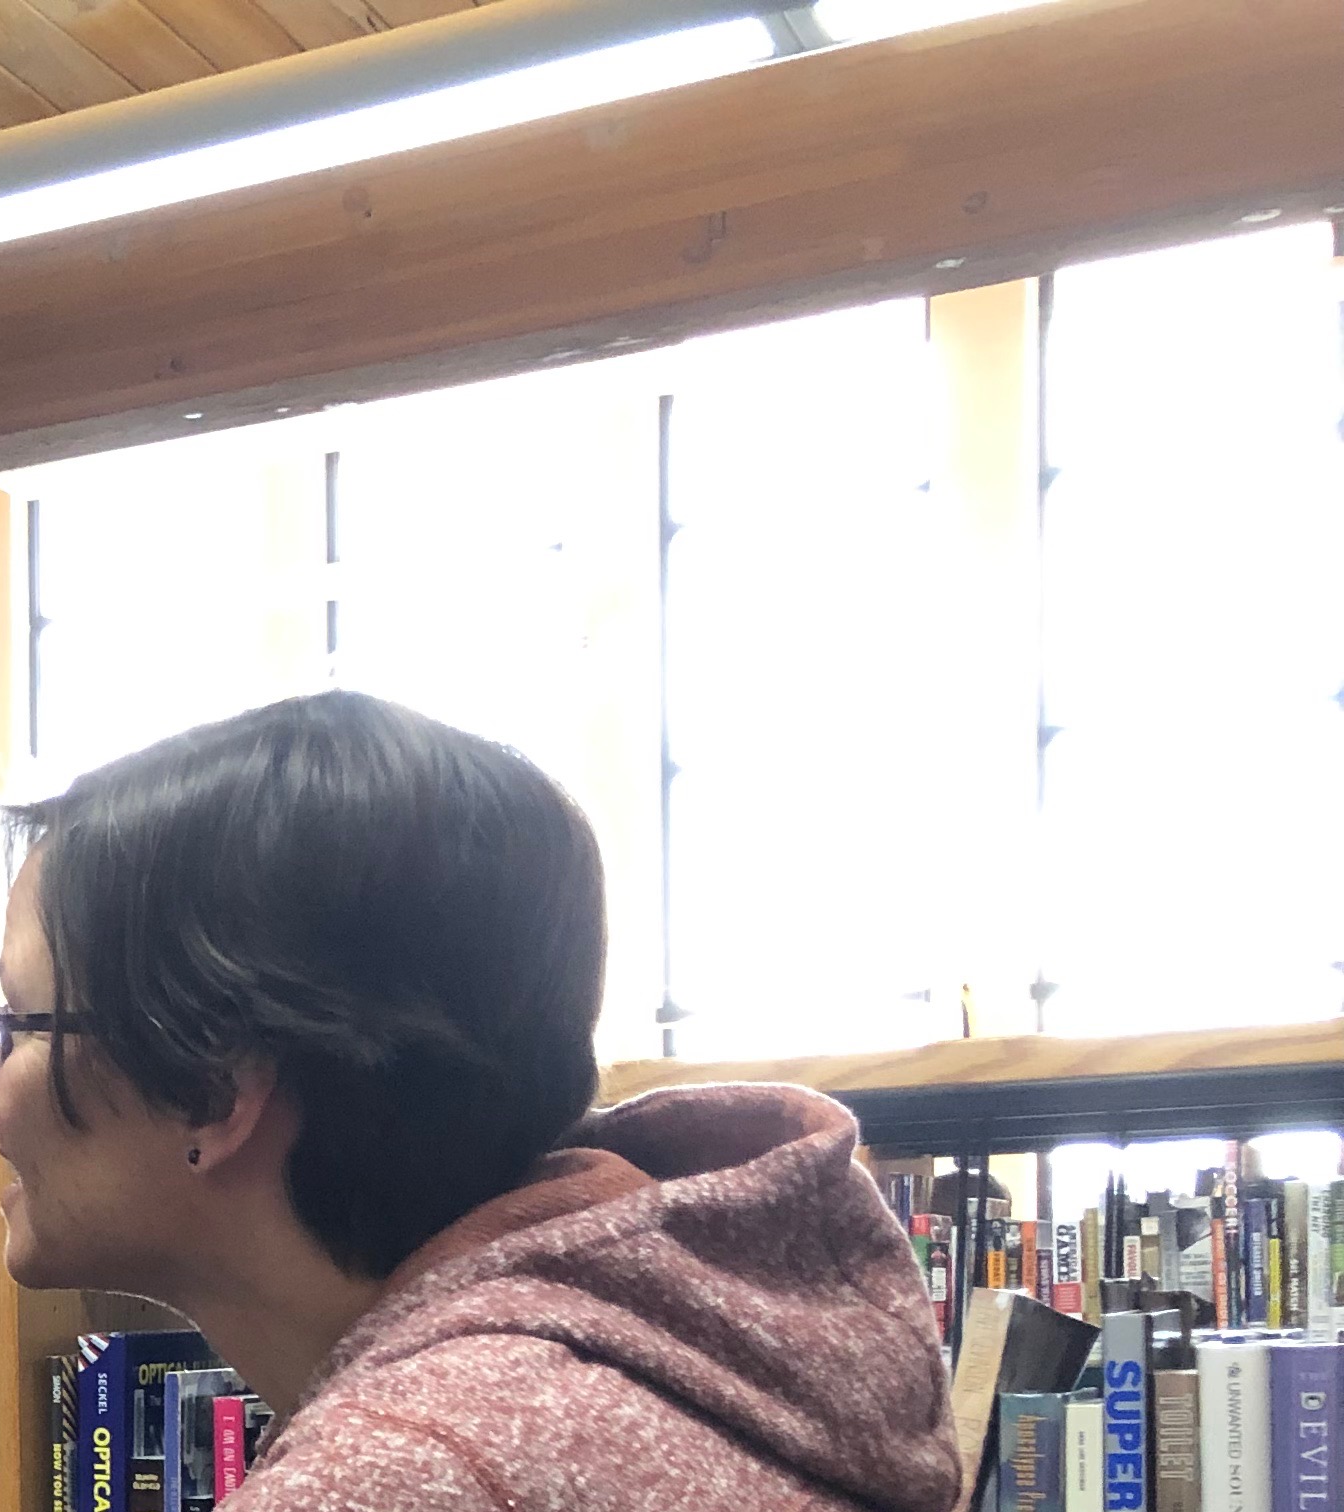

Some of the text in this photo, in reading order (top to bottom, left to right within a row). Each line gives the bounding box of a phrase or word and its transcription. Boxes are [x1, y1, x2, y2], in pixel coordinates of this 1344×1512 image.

[53, 1375, 61, 1404] SIMON
[97, 1372, 108, 1415] SECKEL
[1227, 1382, 1243, 1459] UNWANTED
[1011, 1414, 1047, 1487] Apocalypse
[1105, 1360, 1143, 1511] SUPER
[1158, 1393, 1194, 1483] TOILET
[1298, 1391, 1328, 1511] DEVIL
[53, 1474, 62, 1497] YOU
